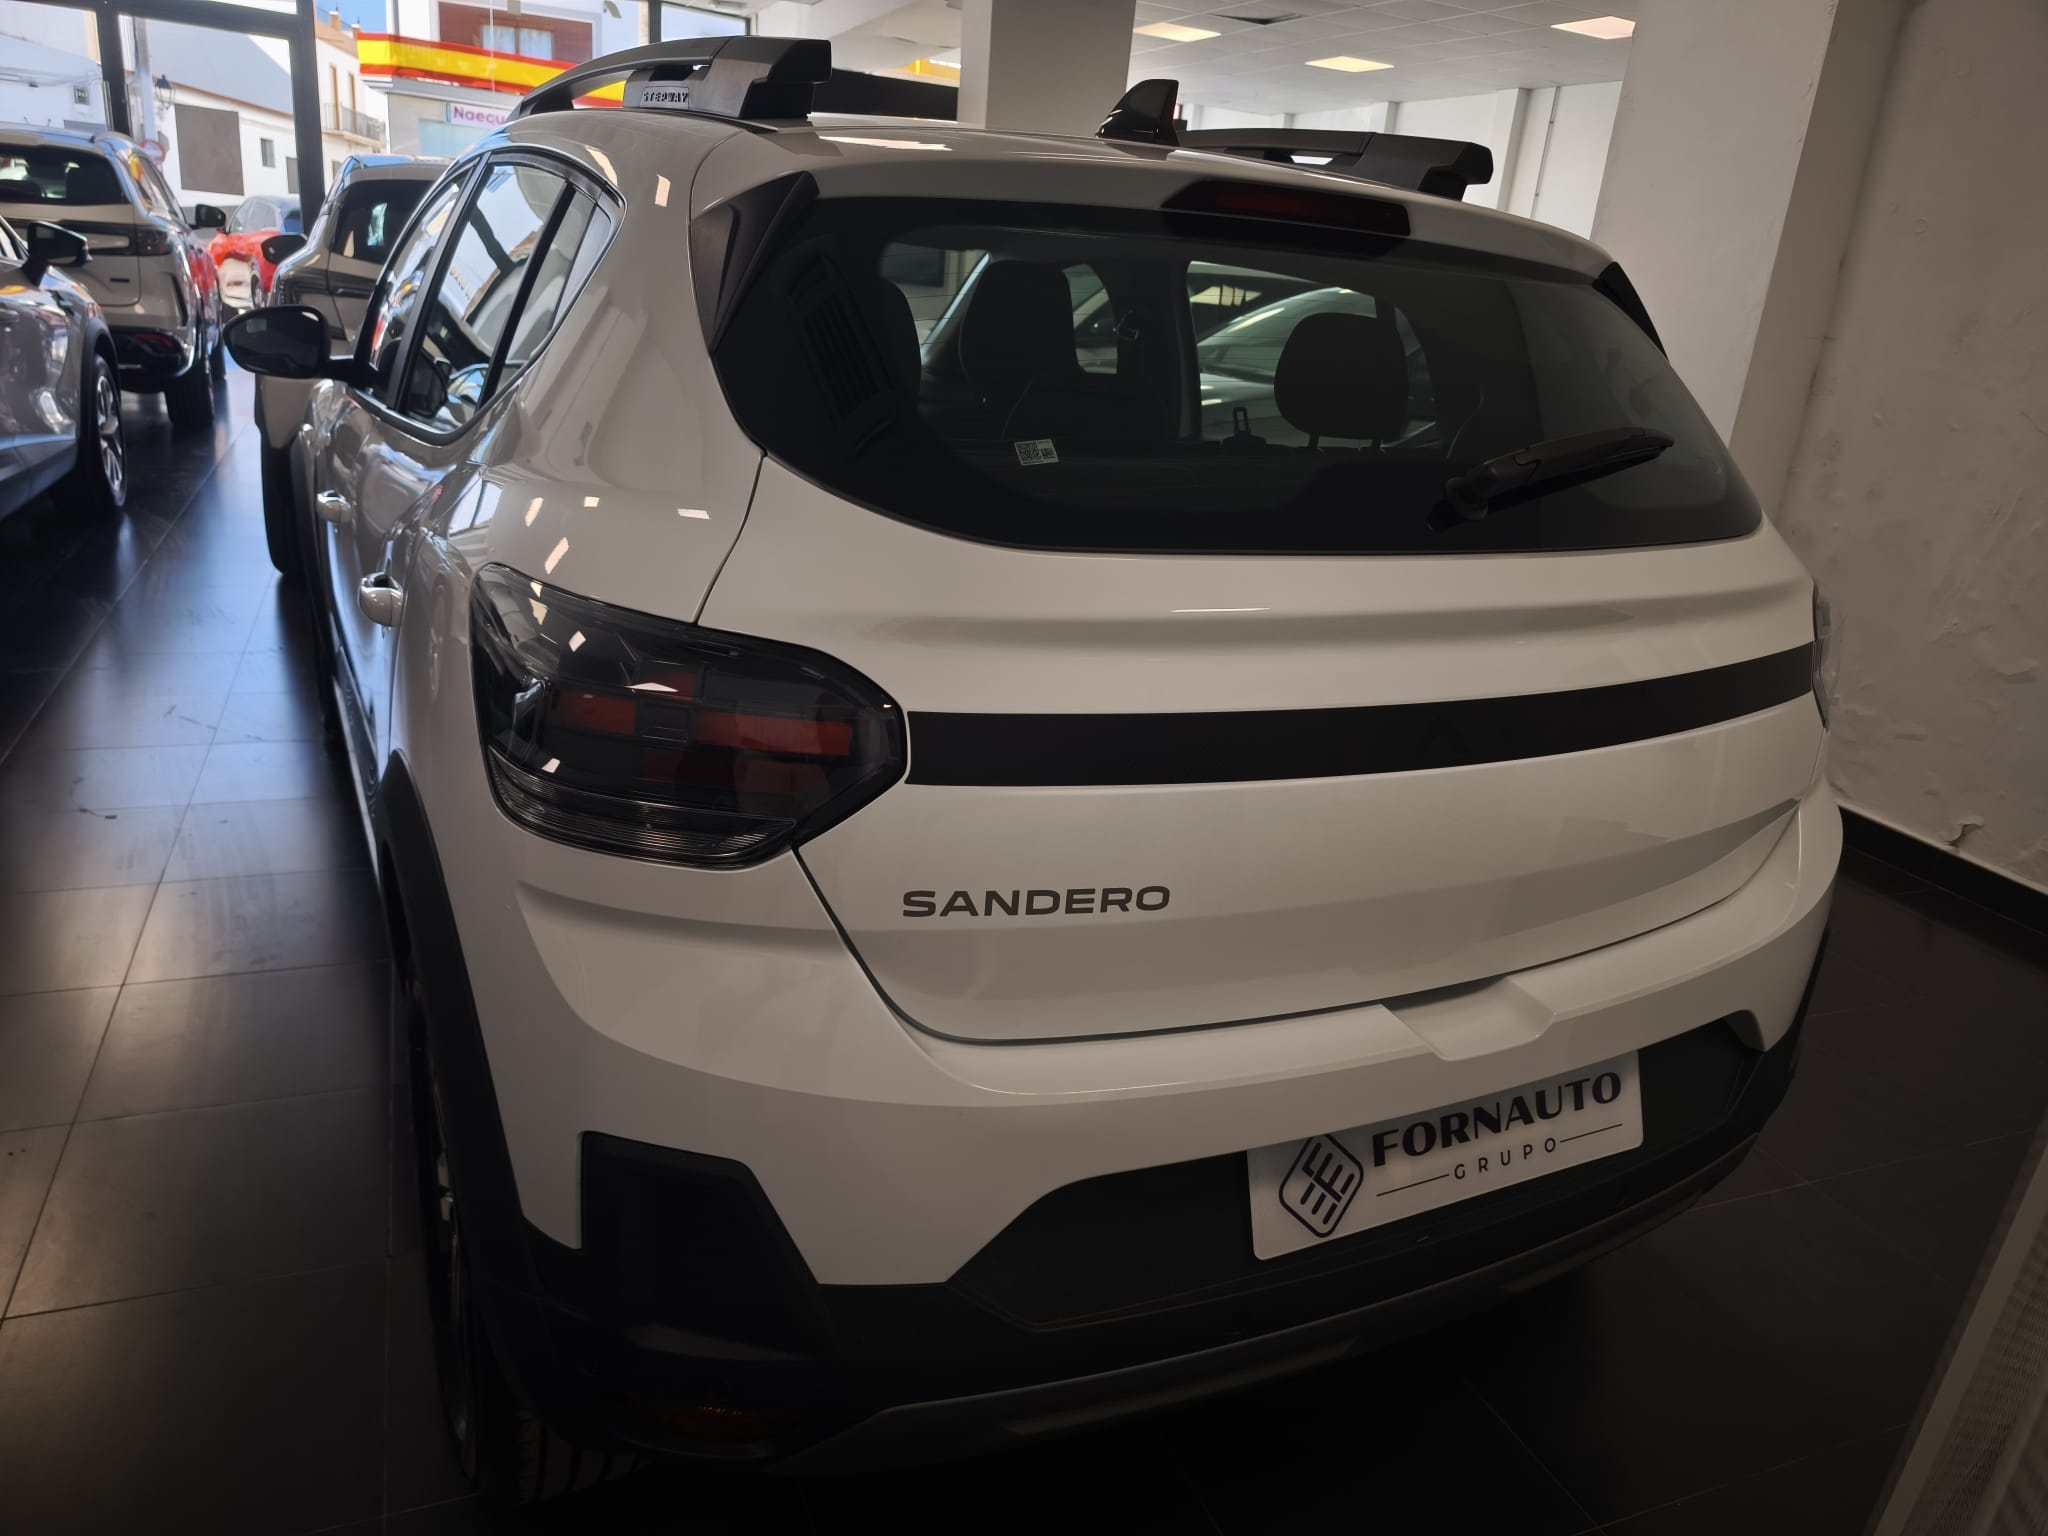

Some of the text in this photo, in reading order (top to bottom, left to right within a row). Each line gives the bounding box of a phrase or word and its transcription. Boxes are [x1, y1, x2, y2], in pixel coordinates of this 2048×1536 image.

[643, 91, 689, 103] STEPWAY
[902, 885, 1170, 917] SANDERO
[1371, 1071, 1622, 1168] FORNAUTO
[1453, 1137, 1557, 1181] GRUPO
